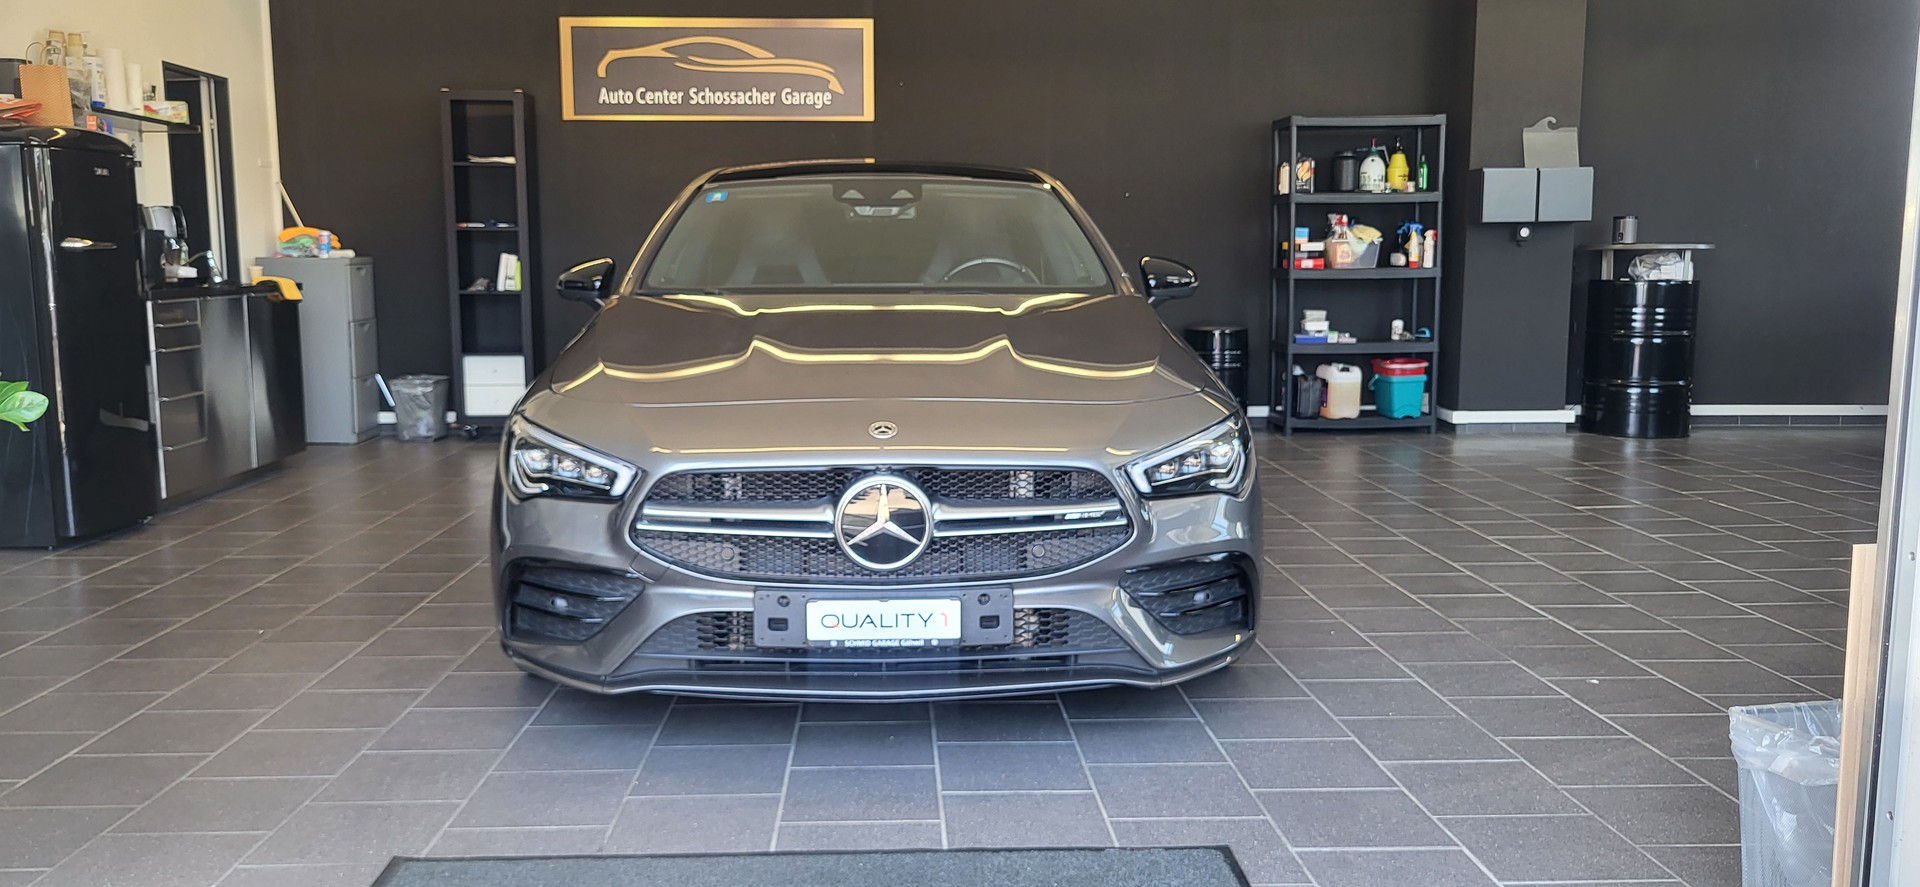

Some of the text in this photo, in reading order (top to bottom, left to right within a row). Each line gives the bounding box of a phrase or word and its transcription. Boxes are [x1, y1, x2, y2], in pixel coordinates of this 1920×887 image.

[598, 87, 832, 109] Auto Center Schossacher Garage
[821, 612, 948, 629] QUALITY 1
[871, 639, 900, 647] GARAGE
